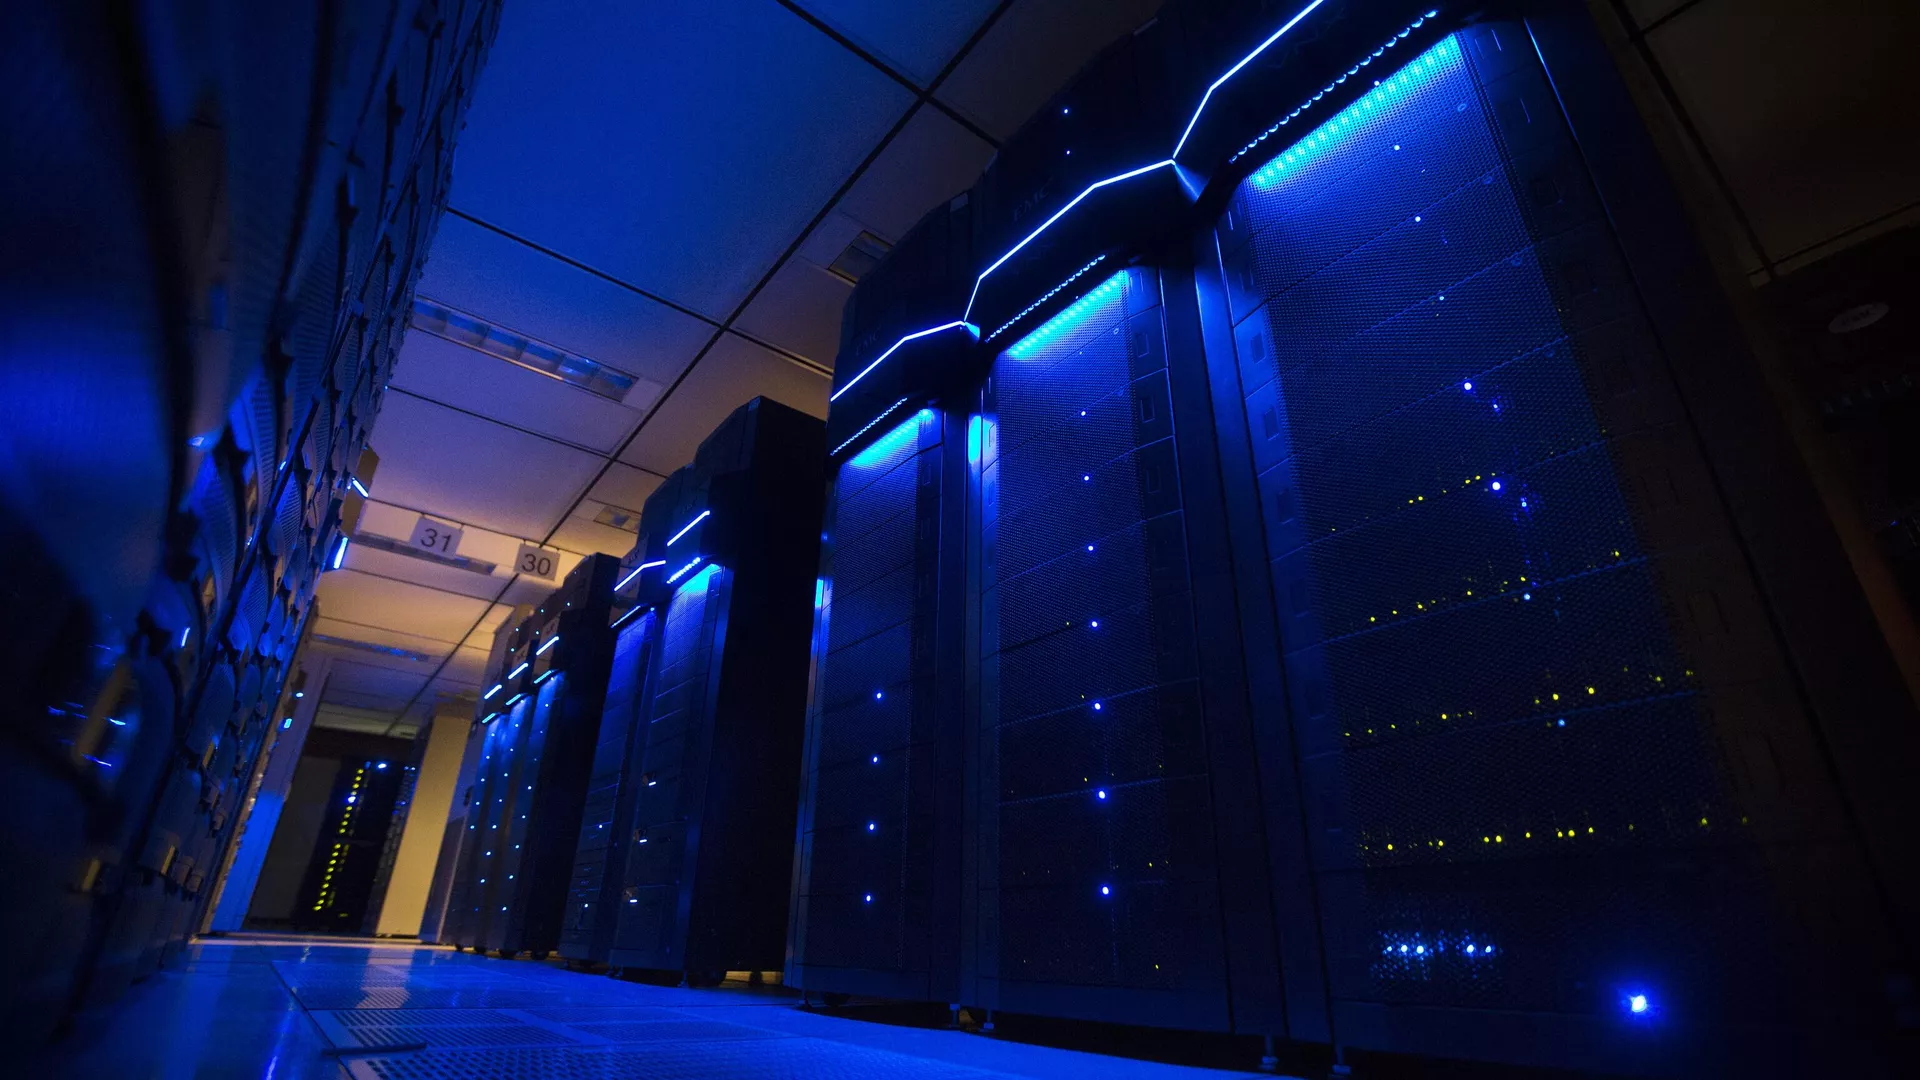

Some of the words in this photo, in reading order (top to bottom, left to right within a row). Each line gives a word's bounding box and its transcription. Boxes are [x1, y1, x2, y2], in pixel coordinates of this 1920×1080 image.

[1013, 175, 1053, 222] EMC
[420, 528, 452, 552] 31
[521, 553, 551, 576] 30
